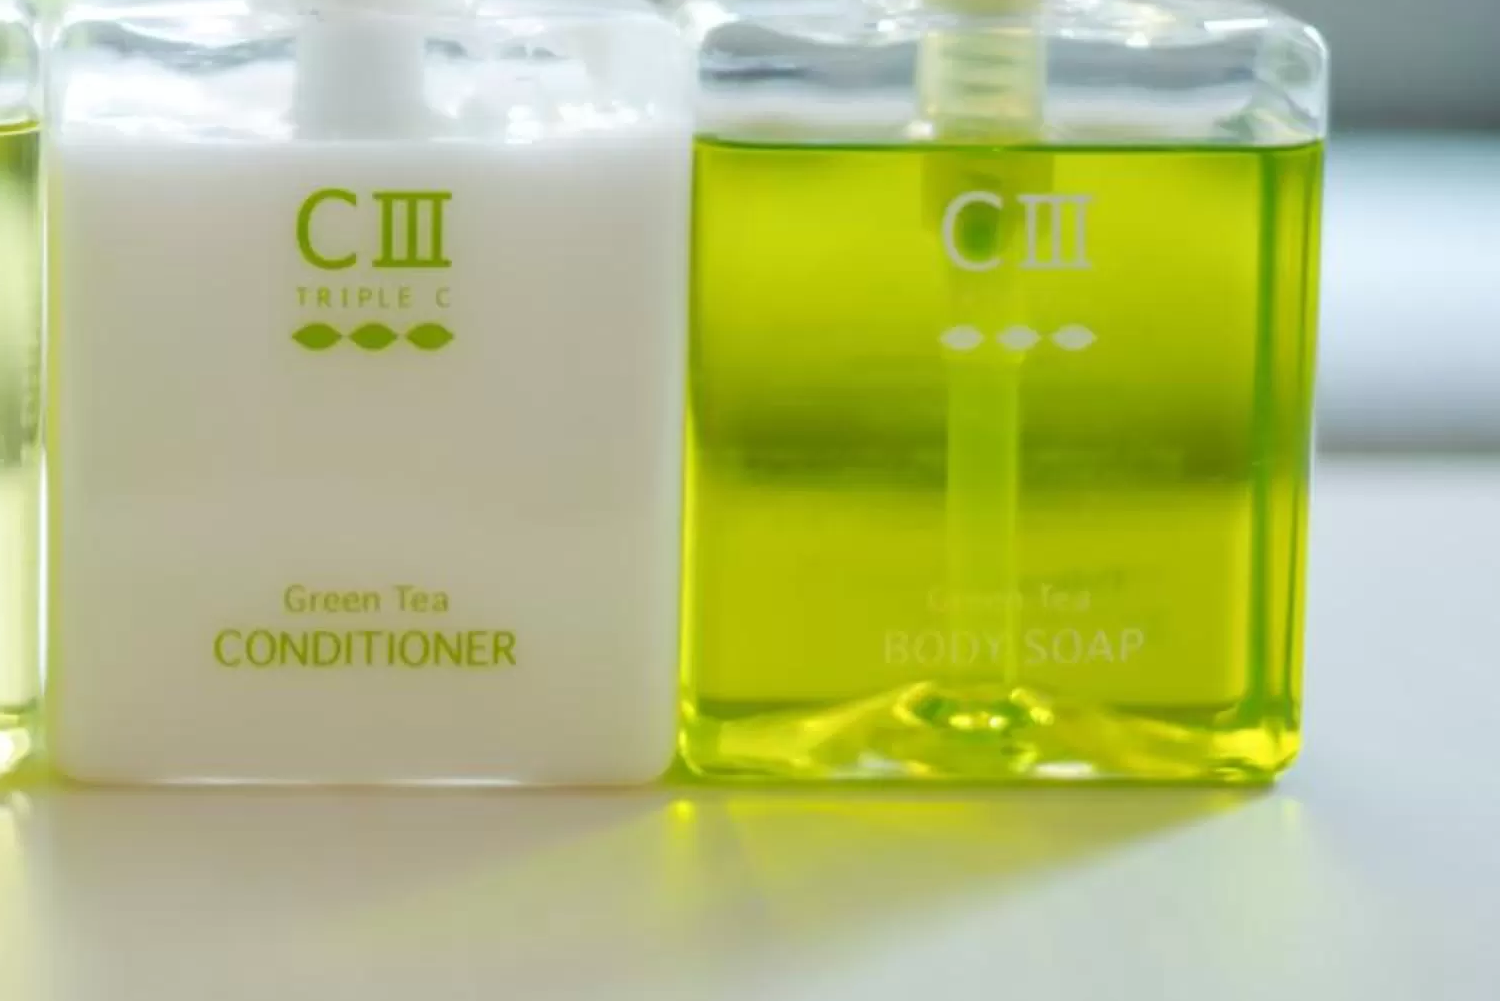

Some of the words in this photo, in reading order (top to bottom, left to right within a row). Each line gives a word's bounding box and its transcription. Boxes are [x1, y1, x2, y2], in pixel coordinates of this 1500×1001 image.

[296, 286, 412, 308] TRIPLE
[435, 286, 452, 308] C
[283, 584, 382, 614] Green
[393, 584, 450, 613] Tea
[212, 628, 518, 668] CONDITIONER
[883, 629, 1005, 665] BODY
[1024, 628, 1145, 665] SOAP
